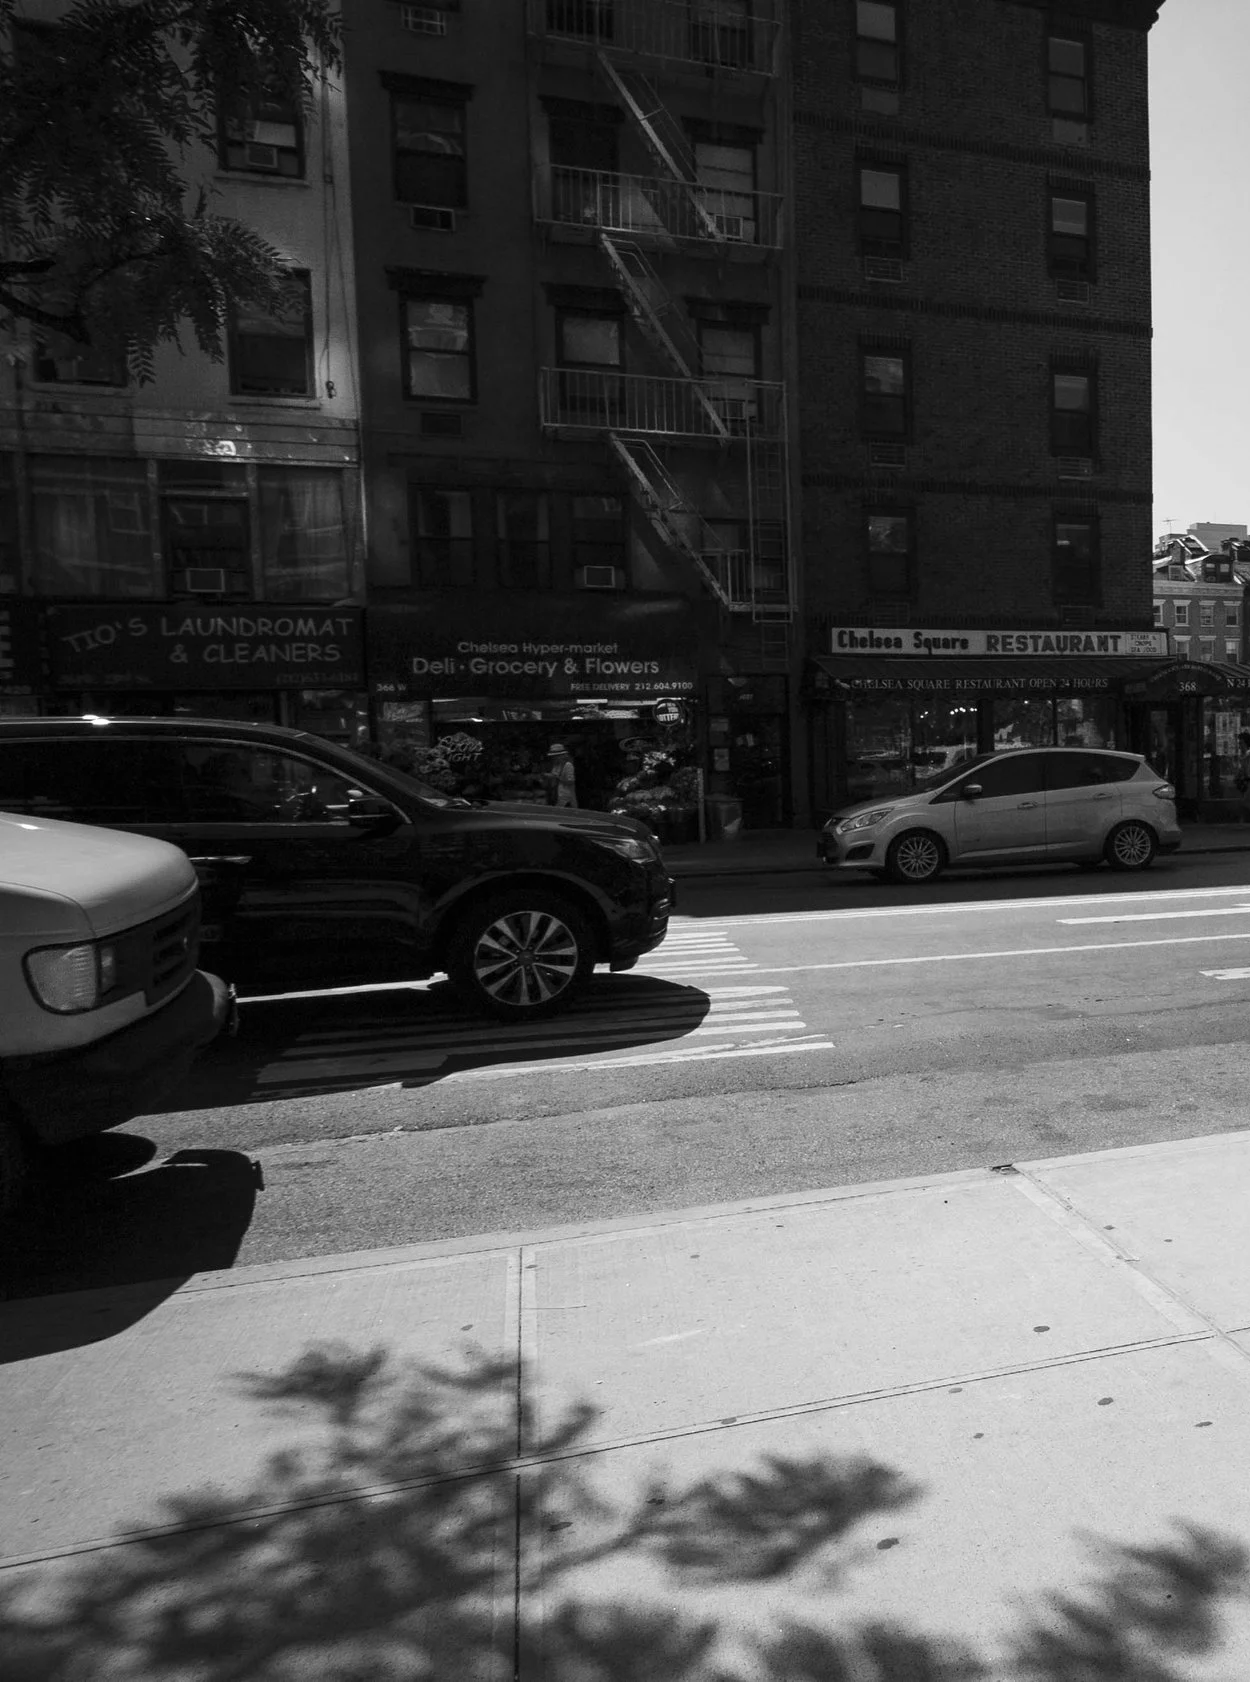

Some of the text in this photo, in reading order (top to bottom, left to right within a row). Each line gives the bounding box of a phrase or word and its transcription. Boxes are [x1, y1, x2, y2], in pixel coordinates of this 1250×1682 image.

[61, 616, 355, 653] TIO'S LAUNDROMAT
[837, 629, 1121, 655] Chelsea Square RESTAURANT
[169, 642, 342, 664] & CLEANERS
[457, 641, 618, 656] Chelsea Hyper-market
[412, 657, 660, 678] Deli Grocery & Flowers
[851, 679, 903, 689] CHELSEA
[907, 679, 951, 691] SQUARE
[955, 678, 1026, 690] RESTAURANT
[1028, 678, 1057, 689] OPEN
[1072, 677, 1109, 689] HOURS
[1178, 680, 1197, 692] 368
